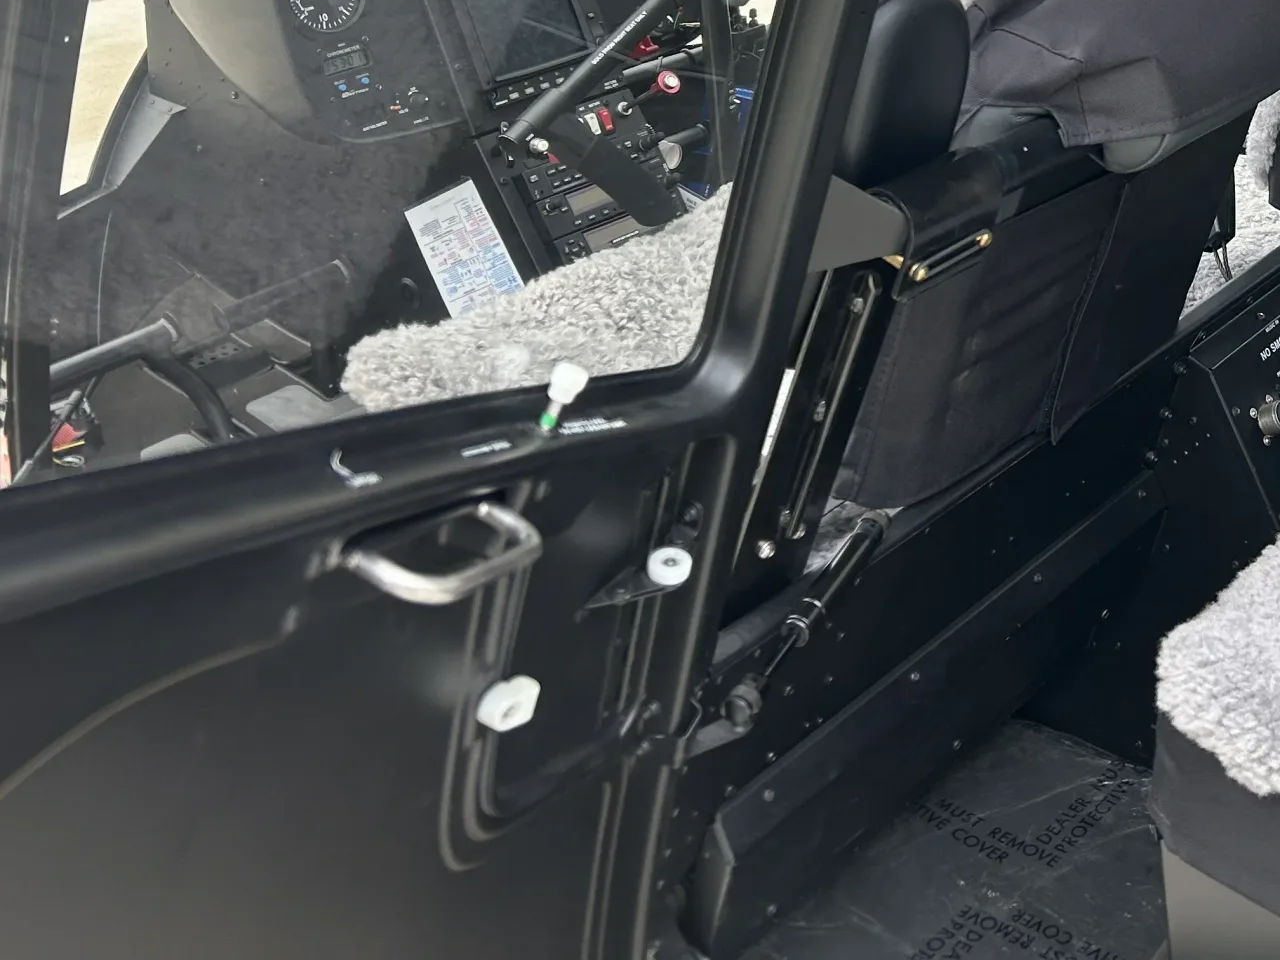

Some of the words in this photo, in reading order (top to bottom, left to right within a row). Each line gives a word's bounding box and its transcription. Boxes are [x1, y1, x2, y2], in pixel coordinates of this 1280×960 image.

[319, 13, 328, 22] 10
[1260, 347, 1271, 361] NO
[936, 798, 985, 828] MUST
[988, 827, 1062, 868] REMOVE
[1036, 797, 1091, 844] DEALER
[1054, 780, 1134, 853] PROTECTIVE
[952, 828, 1009, 864] COVER
[956, 904, 1036, 950] REMOVE
[1011, 908, 1073, 946] COVER
